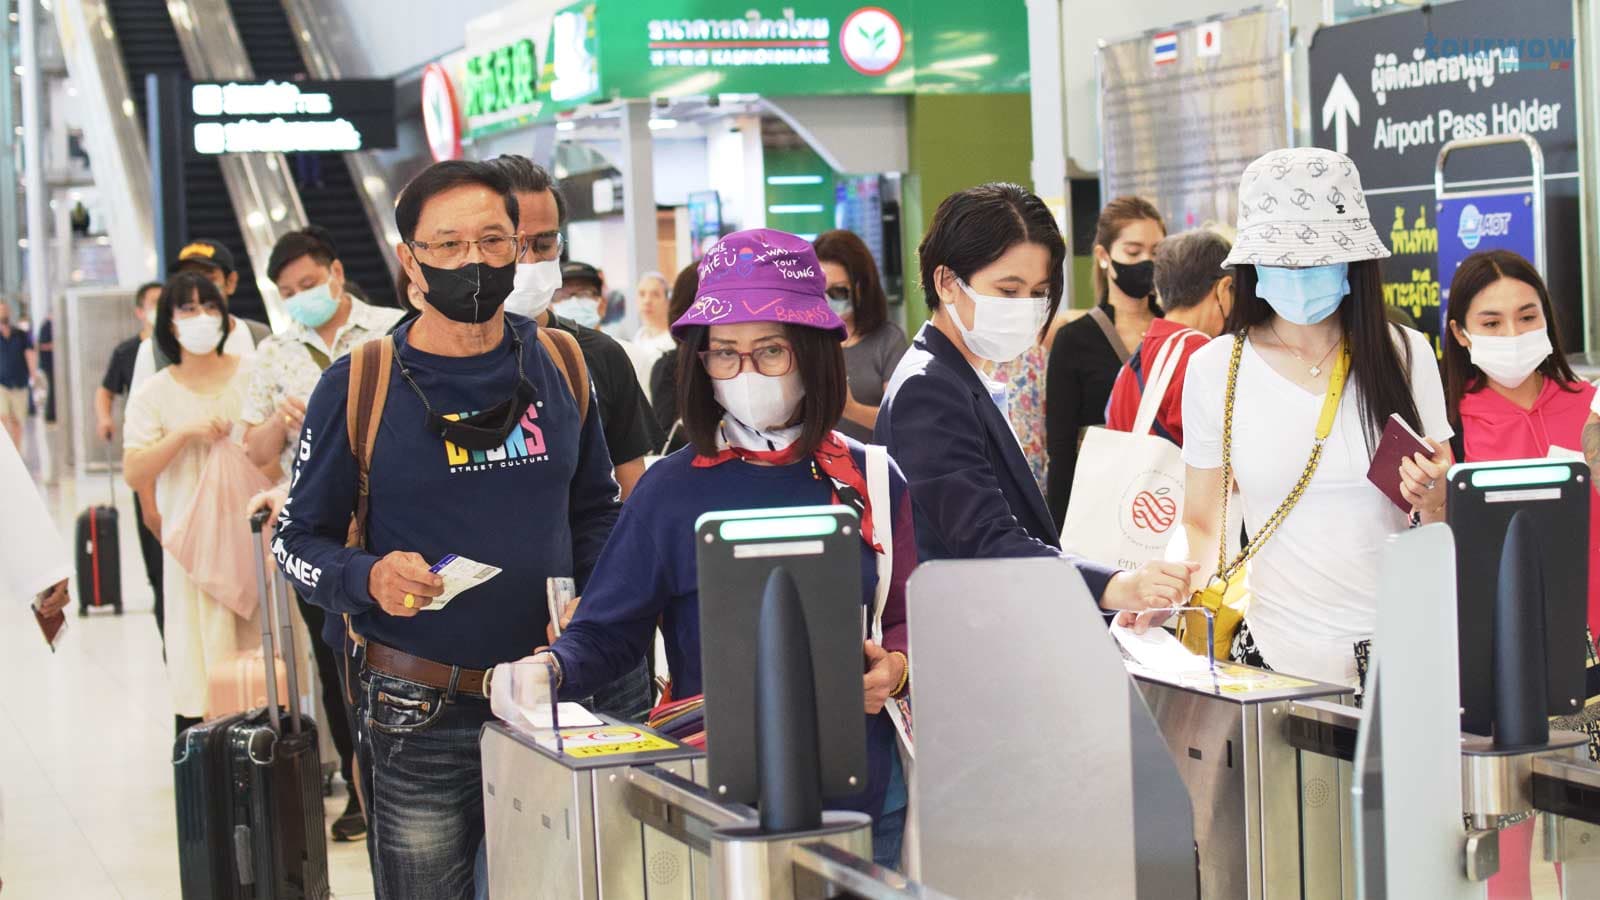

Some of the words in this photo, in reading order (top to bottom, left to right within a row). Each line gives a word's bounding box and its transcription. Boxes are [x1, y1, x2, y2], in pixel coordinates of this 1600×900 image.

[1374, 114, 1435, 155] Airport
[1438, 109, 1488, 141] Pass
[1492, 98, 1561, 136] Holder
[779, 266, 815, 280] YOUNG
[450, 463, 493, 473] STREET
[500, 454, 549, 468] CULTURE
